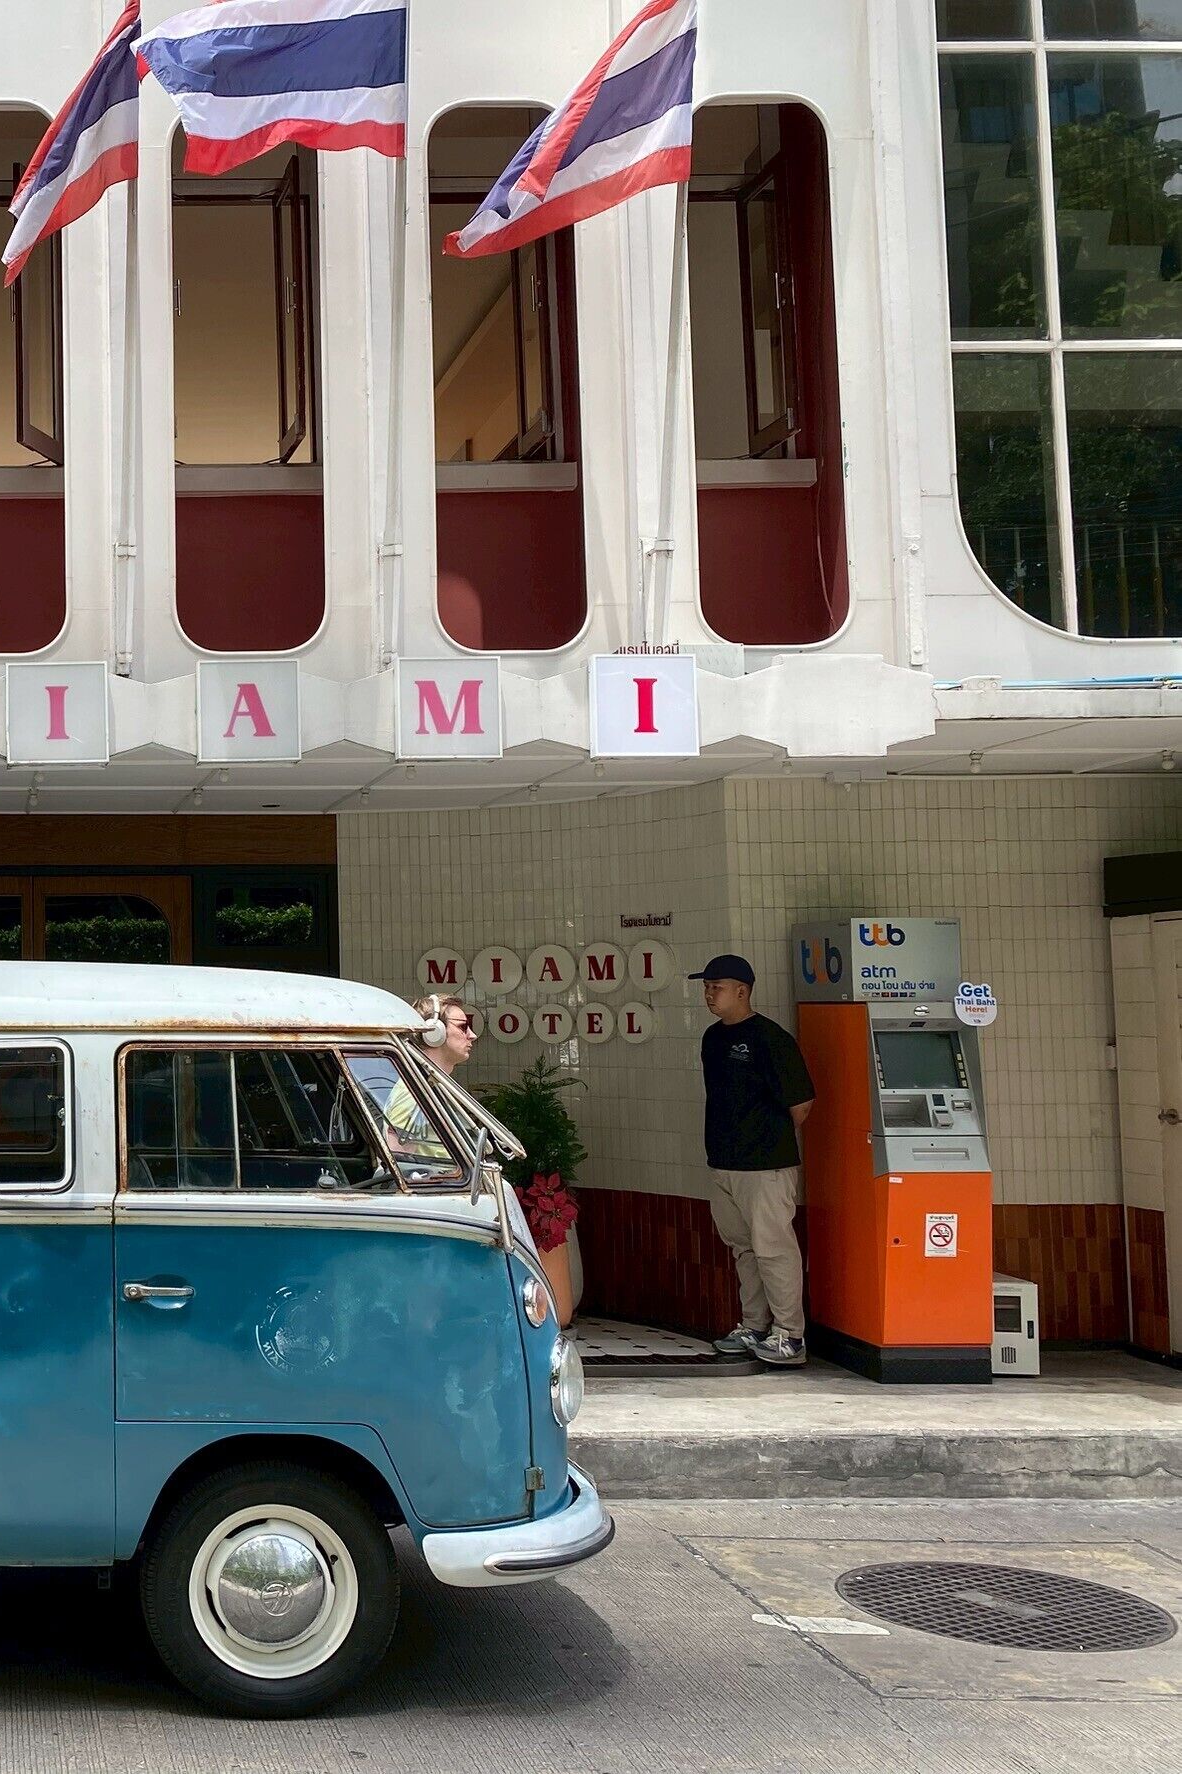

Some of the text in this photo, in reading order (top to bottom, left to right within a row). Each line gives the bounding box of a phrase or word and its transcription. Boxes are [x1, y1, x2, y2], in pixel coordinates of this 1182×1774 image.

[859, 923, 905, 947] ttb
[426, 952, 654, 984] MIAMI
[800, 937, 843, 985] ttb
[861, 965, 897, 978] atm
[960, 984, 990, 997] Get
[976, 998, 995, 1006] Baht
